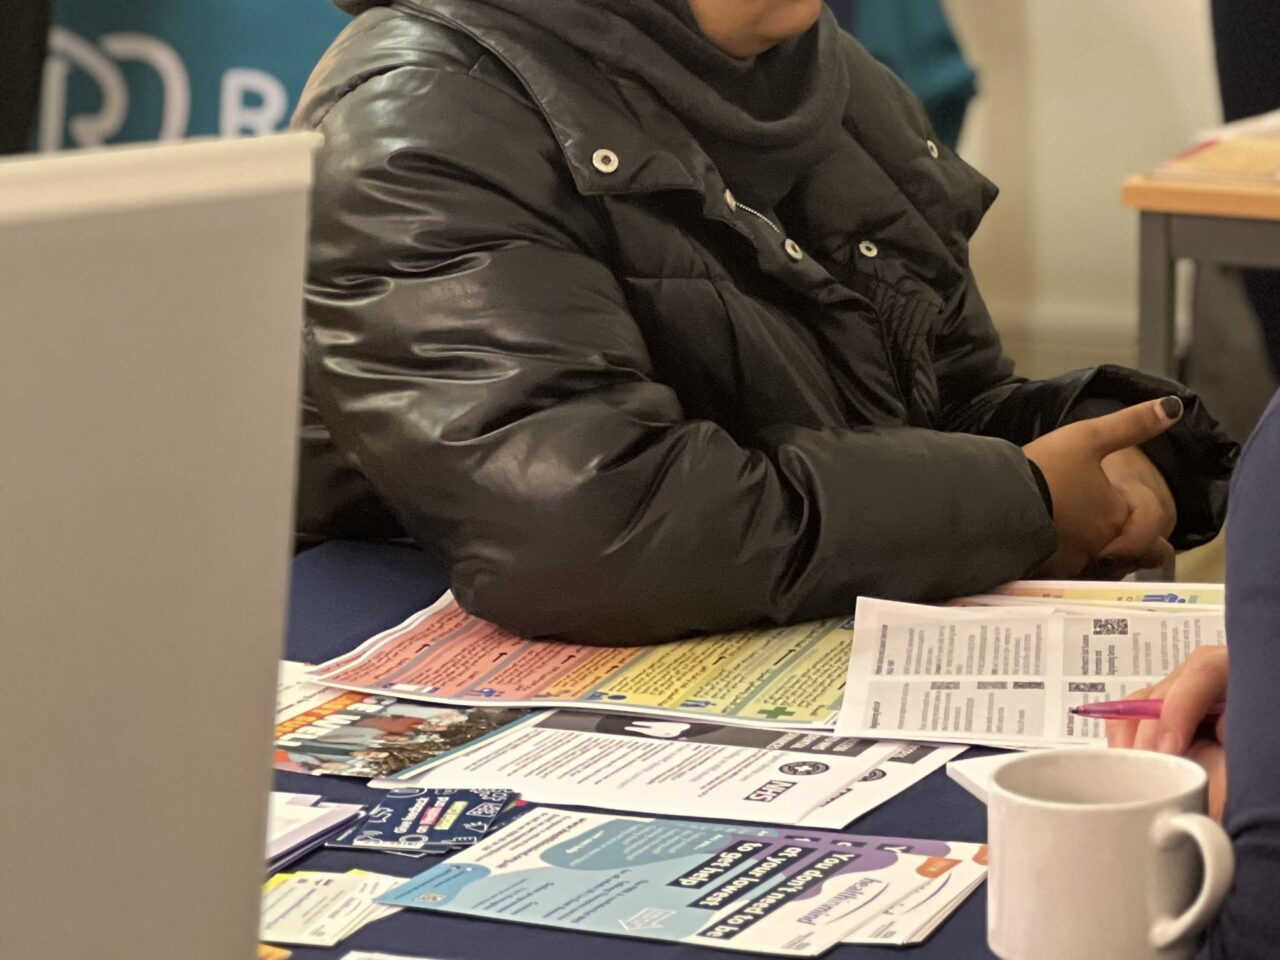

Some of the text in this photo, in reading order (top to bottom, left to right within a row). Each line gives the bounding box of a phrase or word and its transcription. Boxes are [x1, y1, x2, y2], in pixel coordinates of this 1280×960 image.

[748, 780, 790, 801] NHS
[679, 843, 762, 885] to get help
[700, 847, 802, 906] at your lowest
[706, 854, 854, 937] You don't need to be
